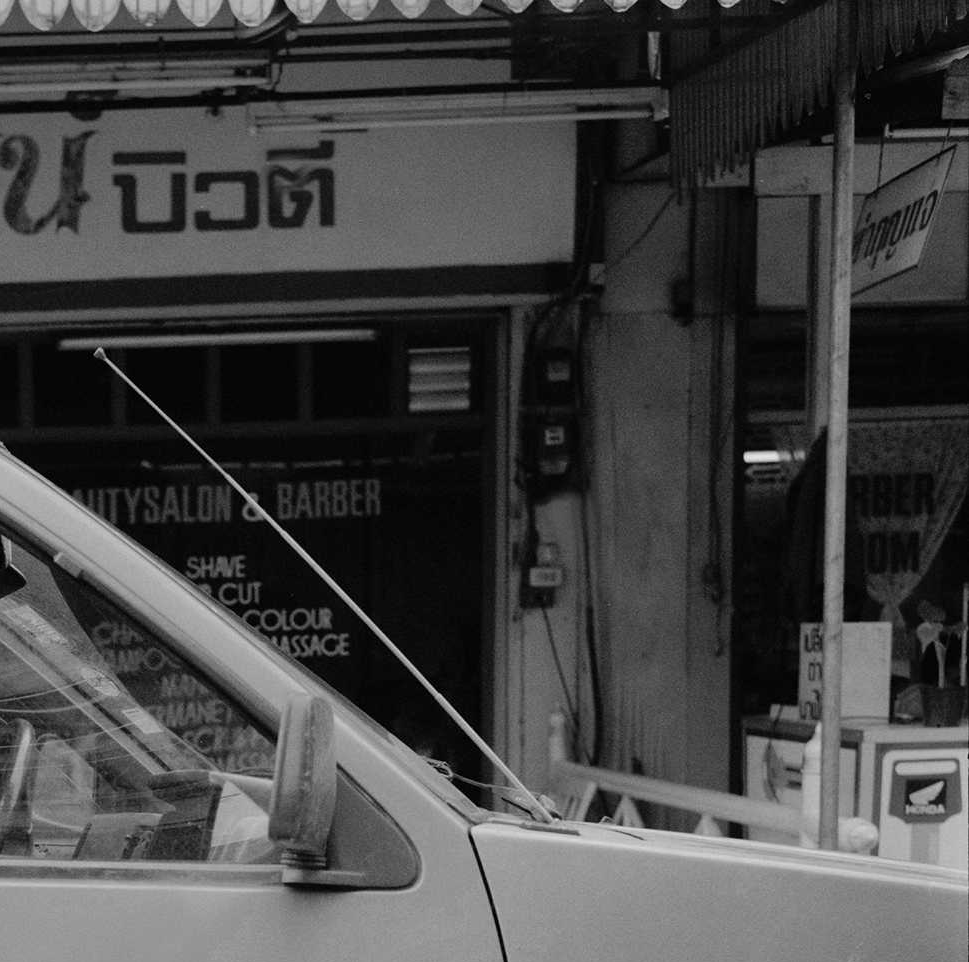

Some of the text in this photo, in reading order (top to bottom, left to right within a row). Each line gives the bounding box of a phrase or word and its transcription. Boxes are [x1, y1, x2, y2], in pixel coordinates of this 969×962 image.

[241, 491, 267, 524] &
[277, 478, 382, 520] BARBER
[185, 554, 247, 580] SHAVE
[218, 580, 263, 606] CUT
[242, 606, 333, 632] COLOUR
[905, 803, 945, 815] HONDA
